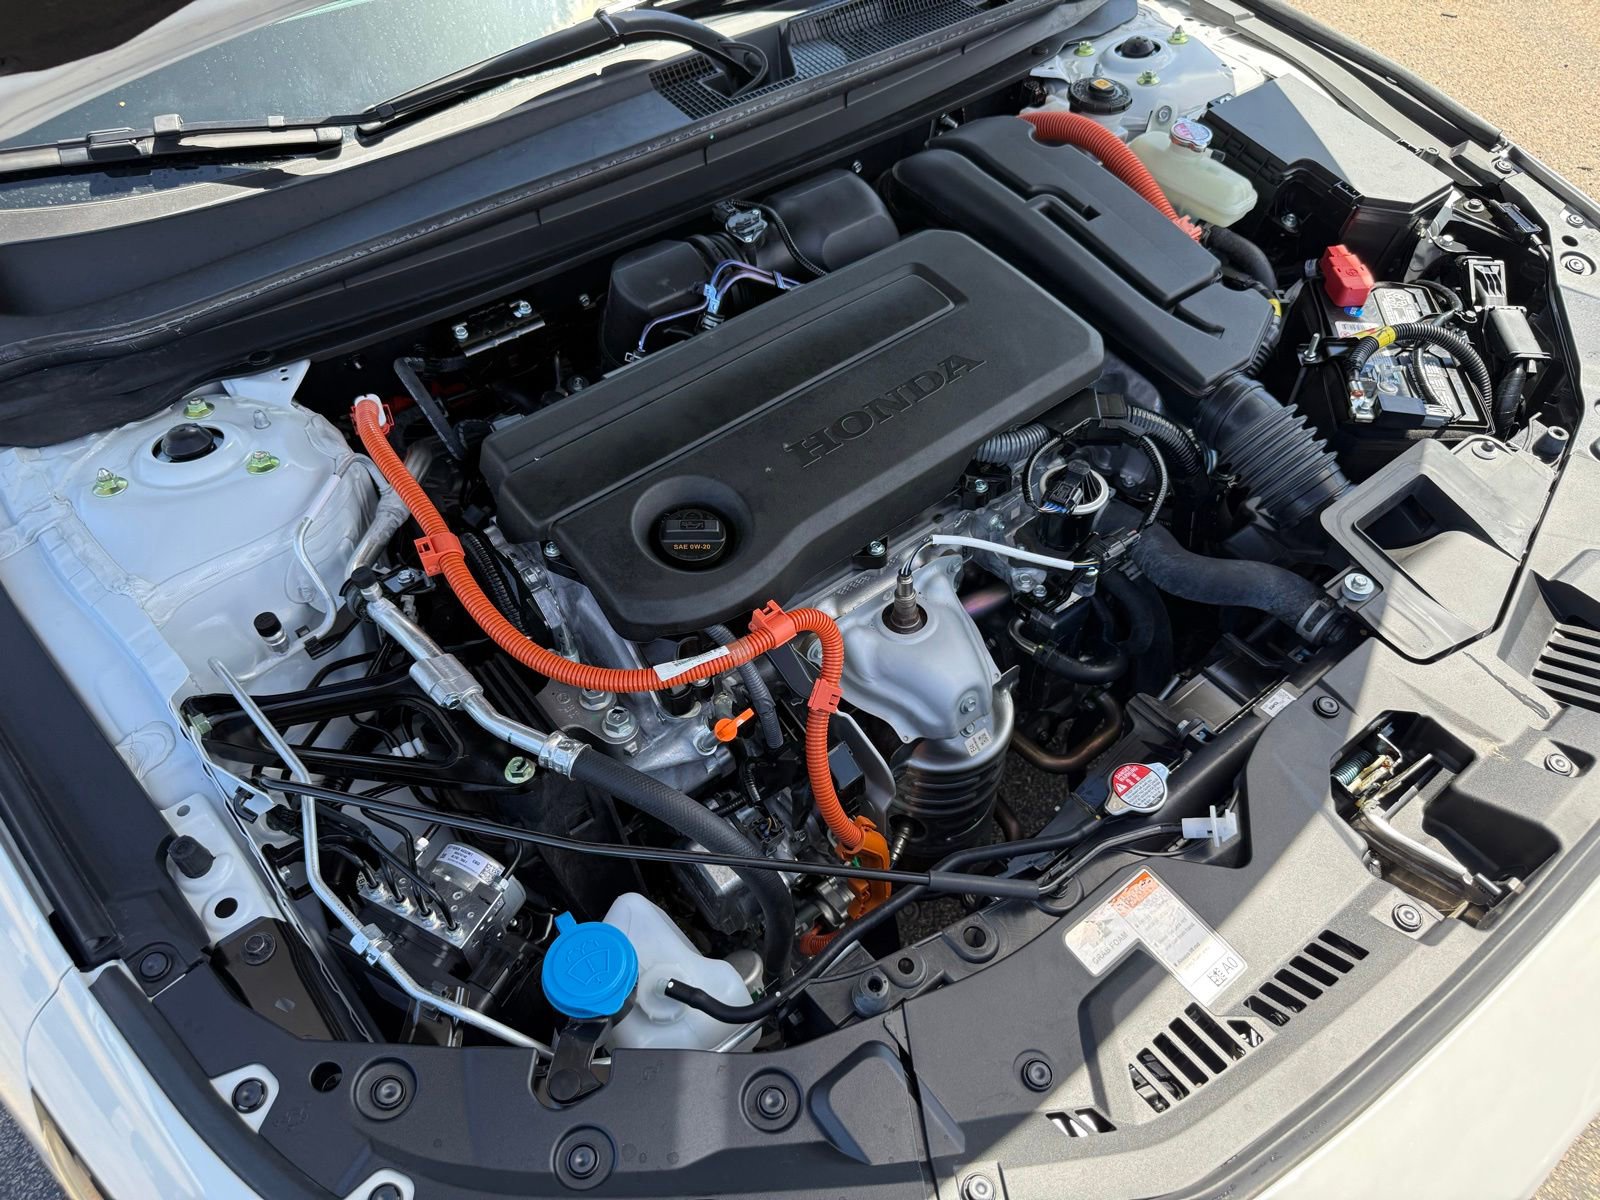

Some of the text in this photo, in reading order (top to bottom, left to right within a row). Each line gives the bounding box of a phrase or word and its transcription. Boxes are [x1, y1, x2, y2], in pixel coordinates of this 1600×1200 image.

[784, 354, 987, 469] HONDA
[1092, 930, 1129, 964] GRAB FOAM
